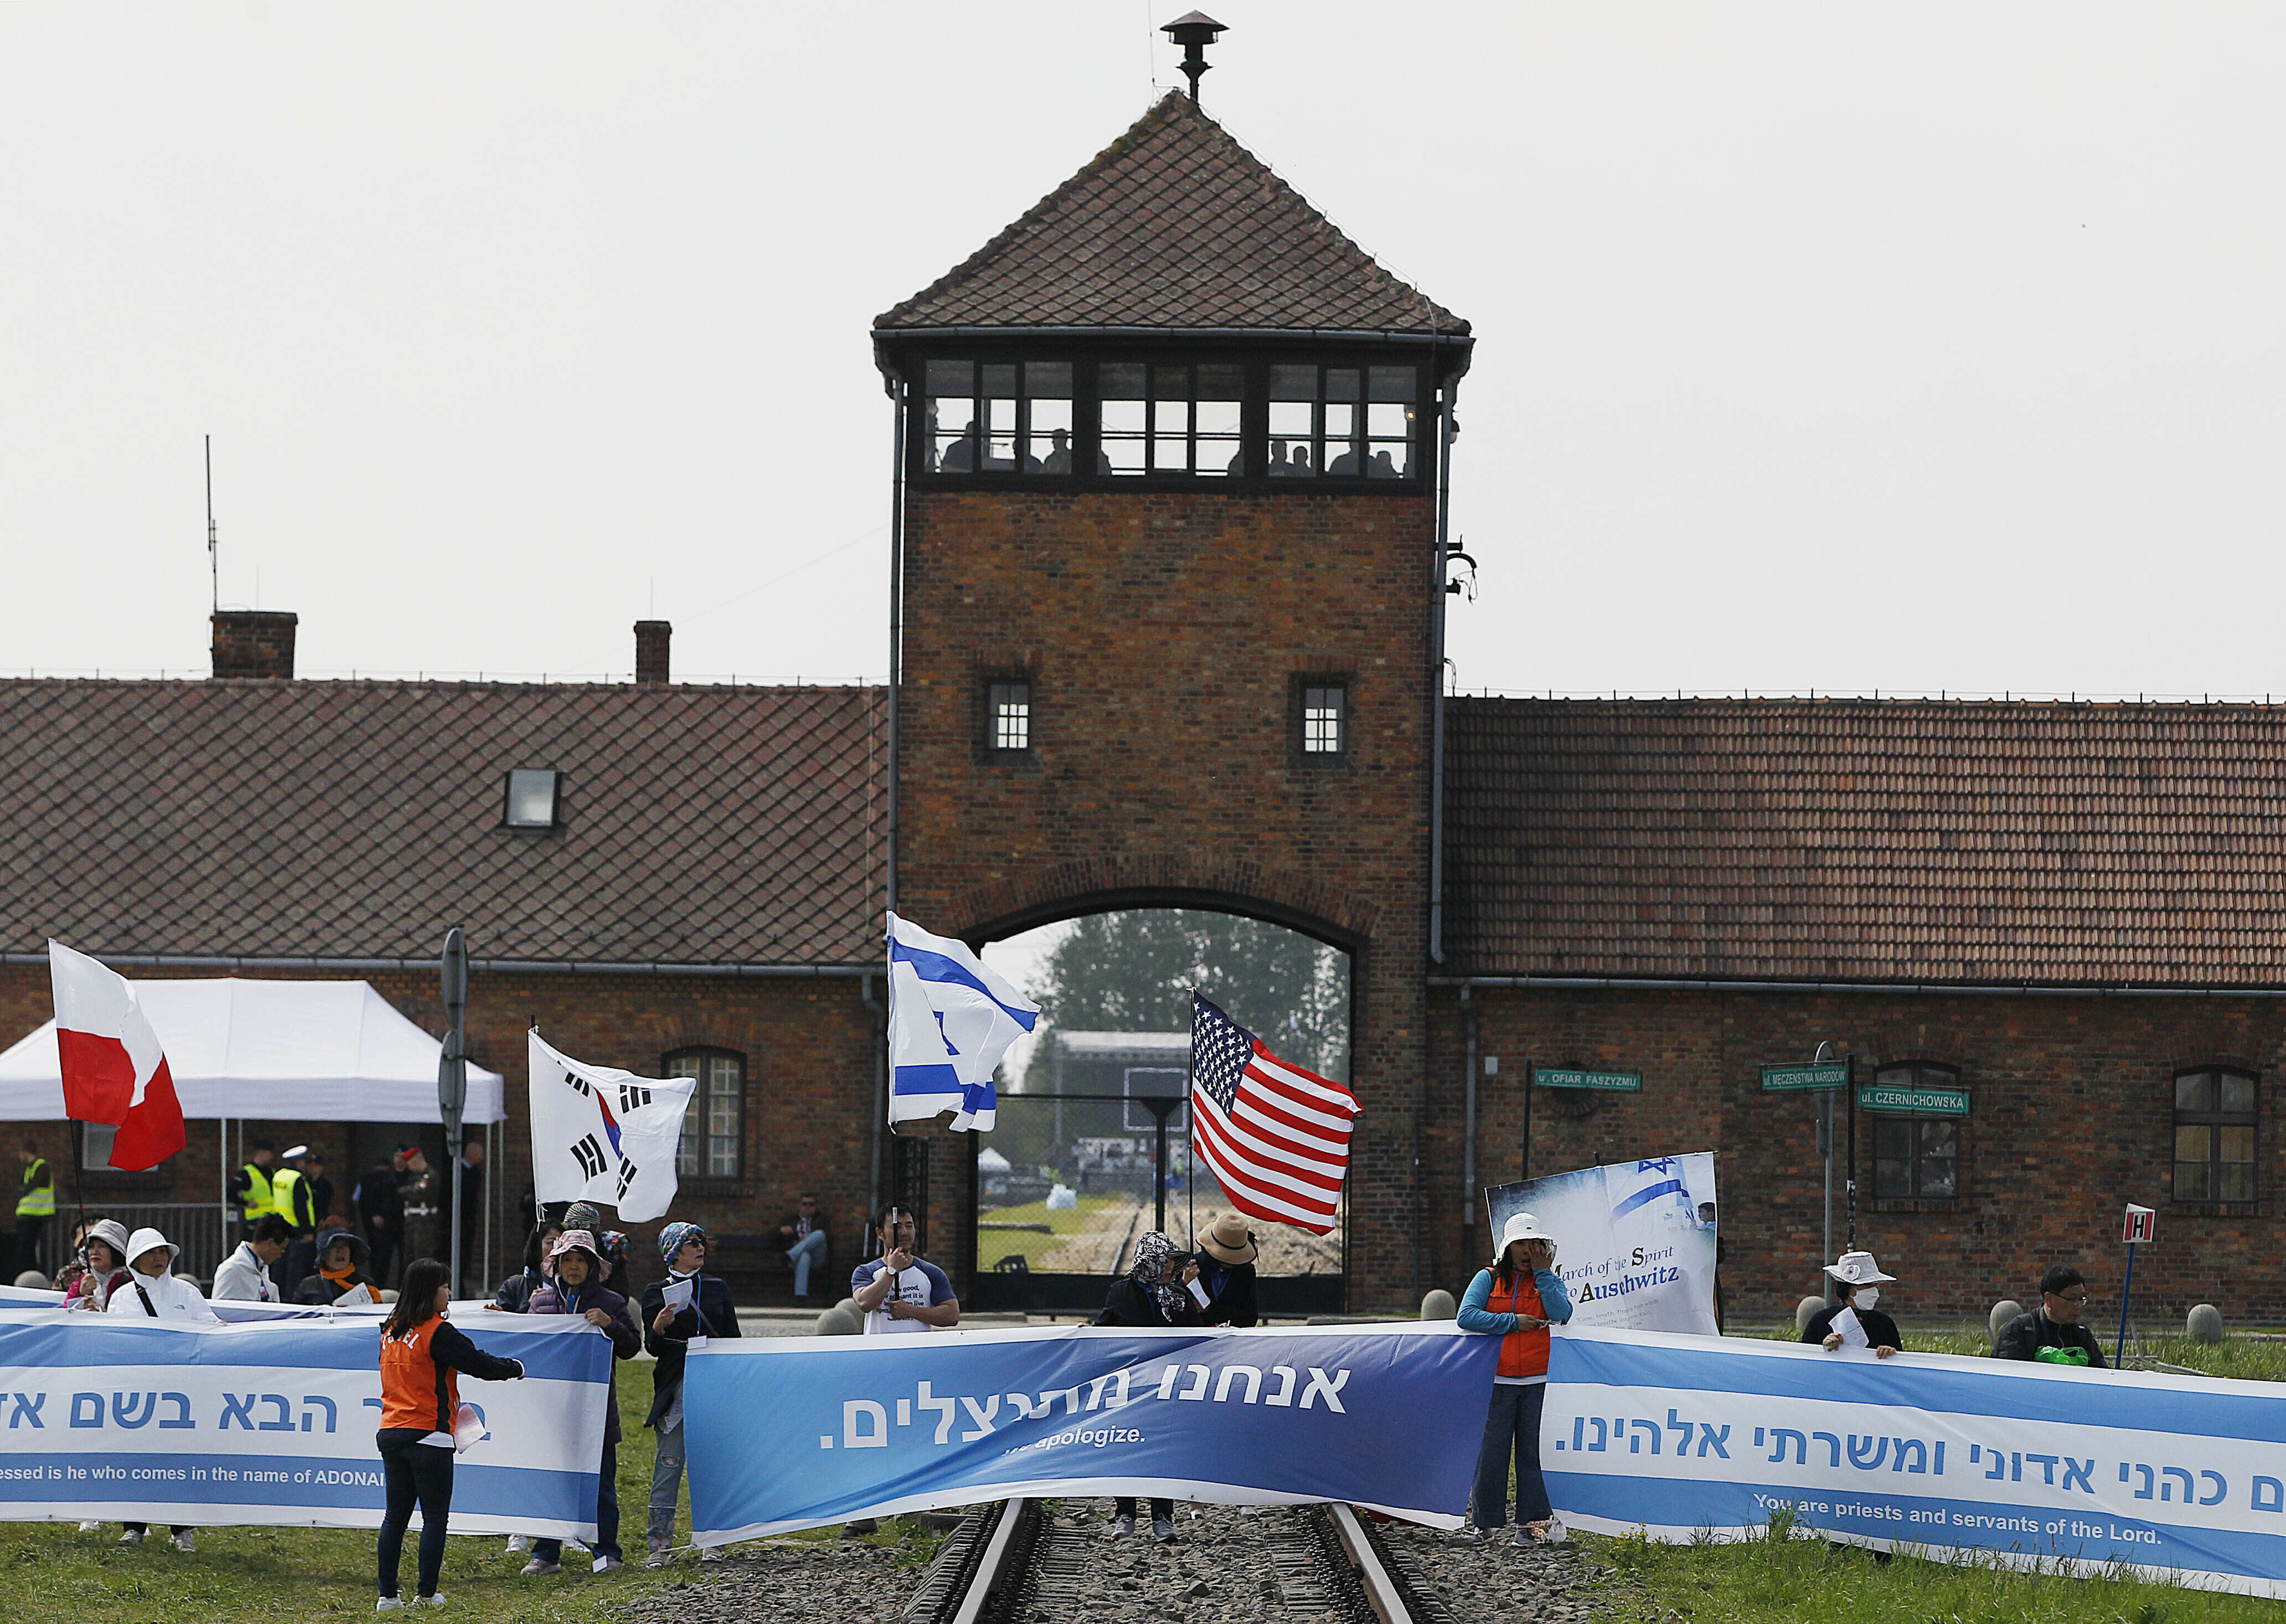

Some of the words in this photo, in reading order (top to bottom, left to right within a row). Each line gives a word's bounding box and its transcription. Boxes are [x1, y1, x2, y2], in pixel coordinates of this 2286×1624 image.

[1552, 1074, 1581, 1084] OFIAR
[1586, 1075, 1637, 1086] FASZYZMU
[1773, 1071, 1814, 1087] MĘCZEŃSTWA
[1815, 1068, 1845, 1082] NARODÓW
[1861, 1091, 1873, 1102] ul.
[1875, 1092, 1964, 1108] CZERNICHOWSKA
[2132, 1215, 2145, 1238] H
[1597, 1257, 1612, 1278] of
[1632, 1246, 1674, 1269] Spirit
[1578, 1266, 1680, 1304] Auschwitz
[1157, 1364, 1352, 1414] אנחנו
[69, 1392, 196, 1430] בשם
[218, 1393, 338, 1434] הבא
[1034, 1425, 1145, 1451] apologize.
[1556, 1408, 1731, 1459] אלהינו.
[1753, 1426, 1946, 1476] ומשרתי
[48, 1466, 62, 1479] is
[67, 1466, 87, 1480] he
[92, 1466, 127, 1480] who
[131, 1468, 187, 1480] comes
[192, 1467, 207, 1481] in
[211, 1468, 238, 1482] the
[242, 1470, 289, 1483] name
[294, 1469, 313, 1484] of
[1969, 1443, 2096, 1494] אדוני
[2118, 1461, 2228, 1507] כהני
[1753, 1493, 1792, 1511] You
[1799, 1497, 1829, 1513] are
[1835, 1502, 1903, 1521] priests
[1910, 1508, 1946, 1524] and
[1952, 1513, 2039, 1533] servants
[2046, 1518, 2066, 1535] of
[2071, 1520, 2104, 1539] the
[2110, 1523, 2162, 1545] Lord.
